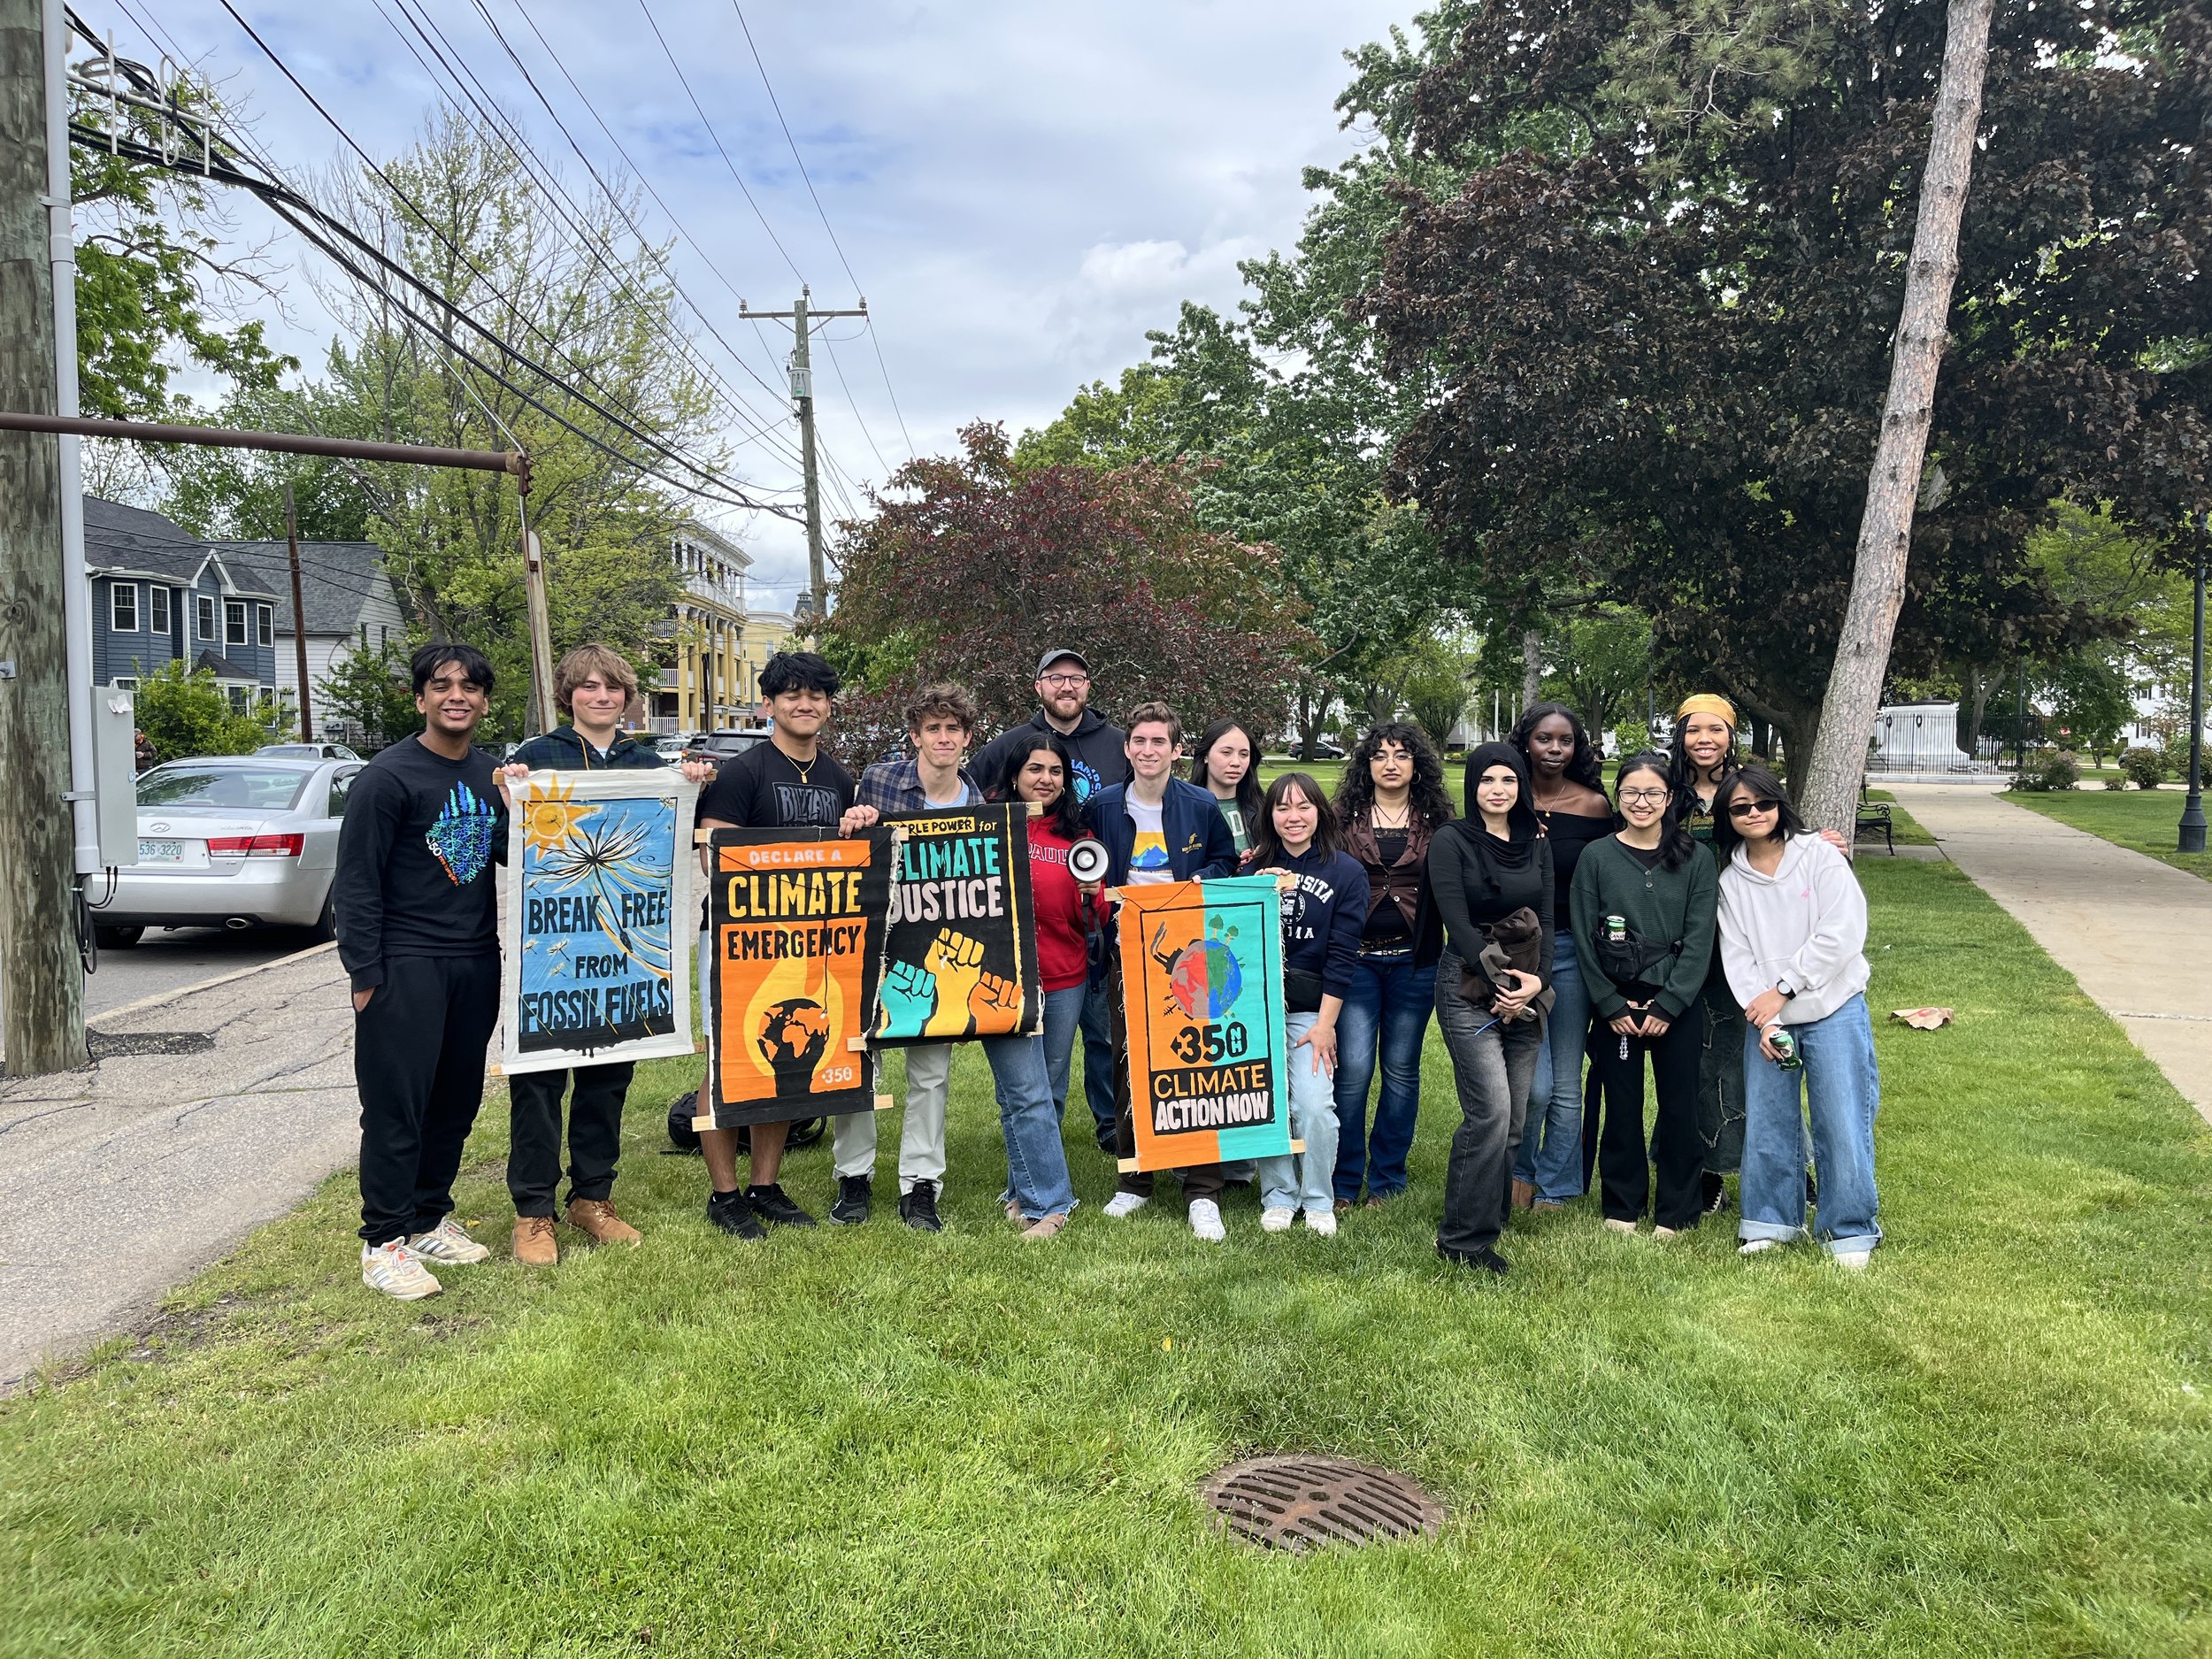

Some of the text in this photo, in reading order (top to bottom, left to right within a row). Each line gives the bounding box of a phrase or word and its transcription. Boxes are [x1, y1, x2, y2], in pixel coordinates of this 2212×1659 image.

[778, 786, 841, 826] BLIZZARD
[886, 819, 998, 834] PLE POWER for
[139, 844, 182, 856] 536 3220
[749, 849, 842, 865] DECLARE A
[896, 837, 1002, 881] LIMATE
[527, 890, 668, 935] BREAK FREE
[727, 871, 864, 918] CLIMATE
[888, 876, 1004, 925] JUSTICE
[726, 926, 862, 961] EMERGENCY
[575, 952, 628, 979] FROM
[520, 977, 672, 1034] FOSSIL FUELS
[1178, 1021, 1248, 1064] 350
[825, 1066, 853, 1084] 350
[1154, 1064, 1266, 1099] CLIMATE
[1155, 1091, 1270, 1132] ACTION NOW
